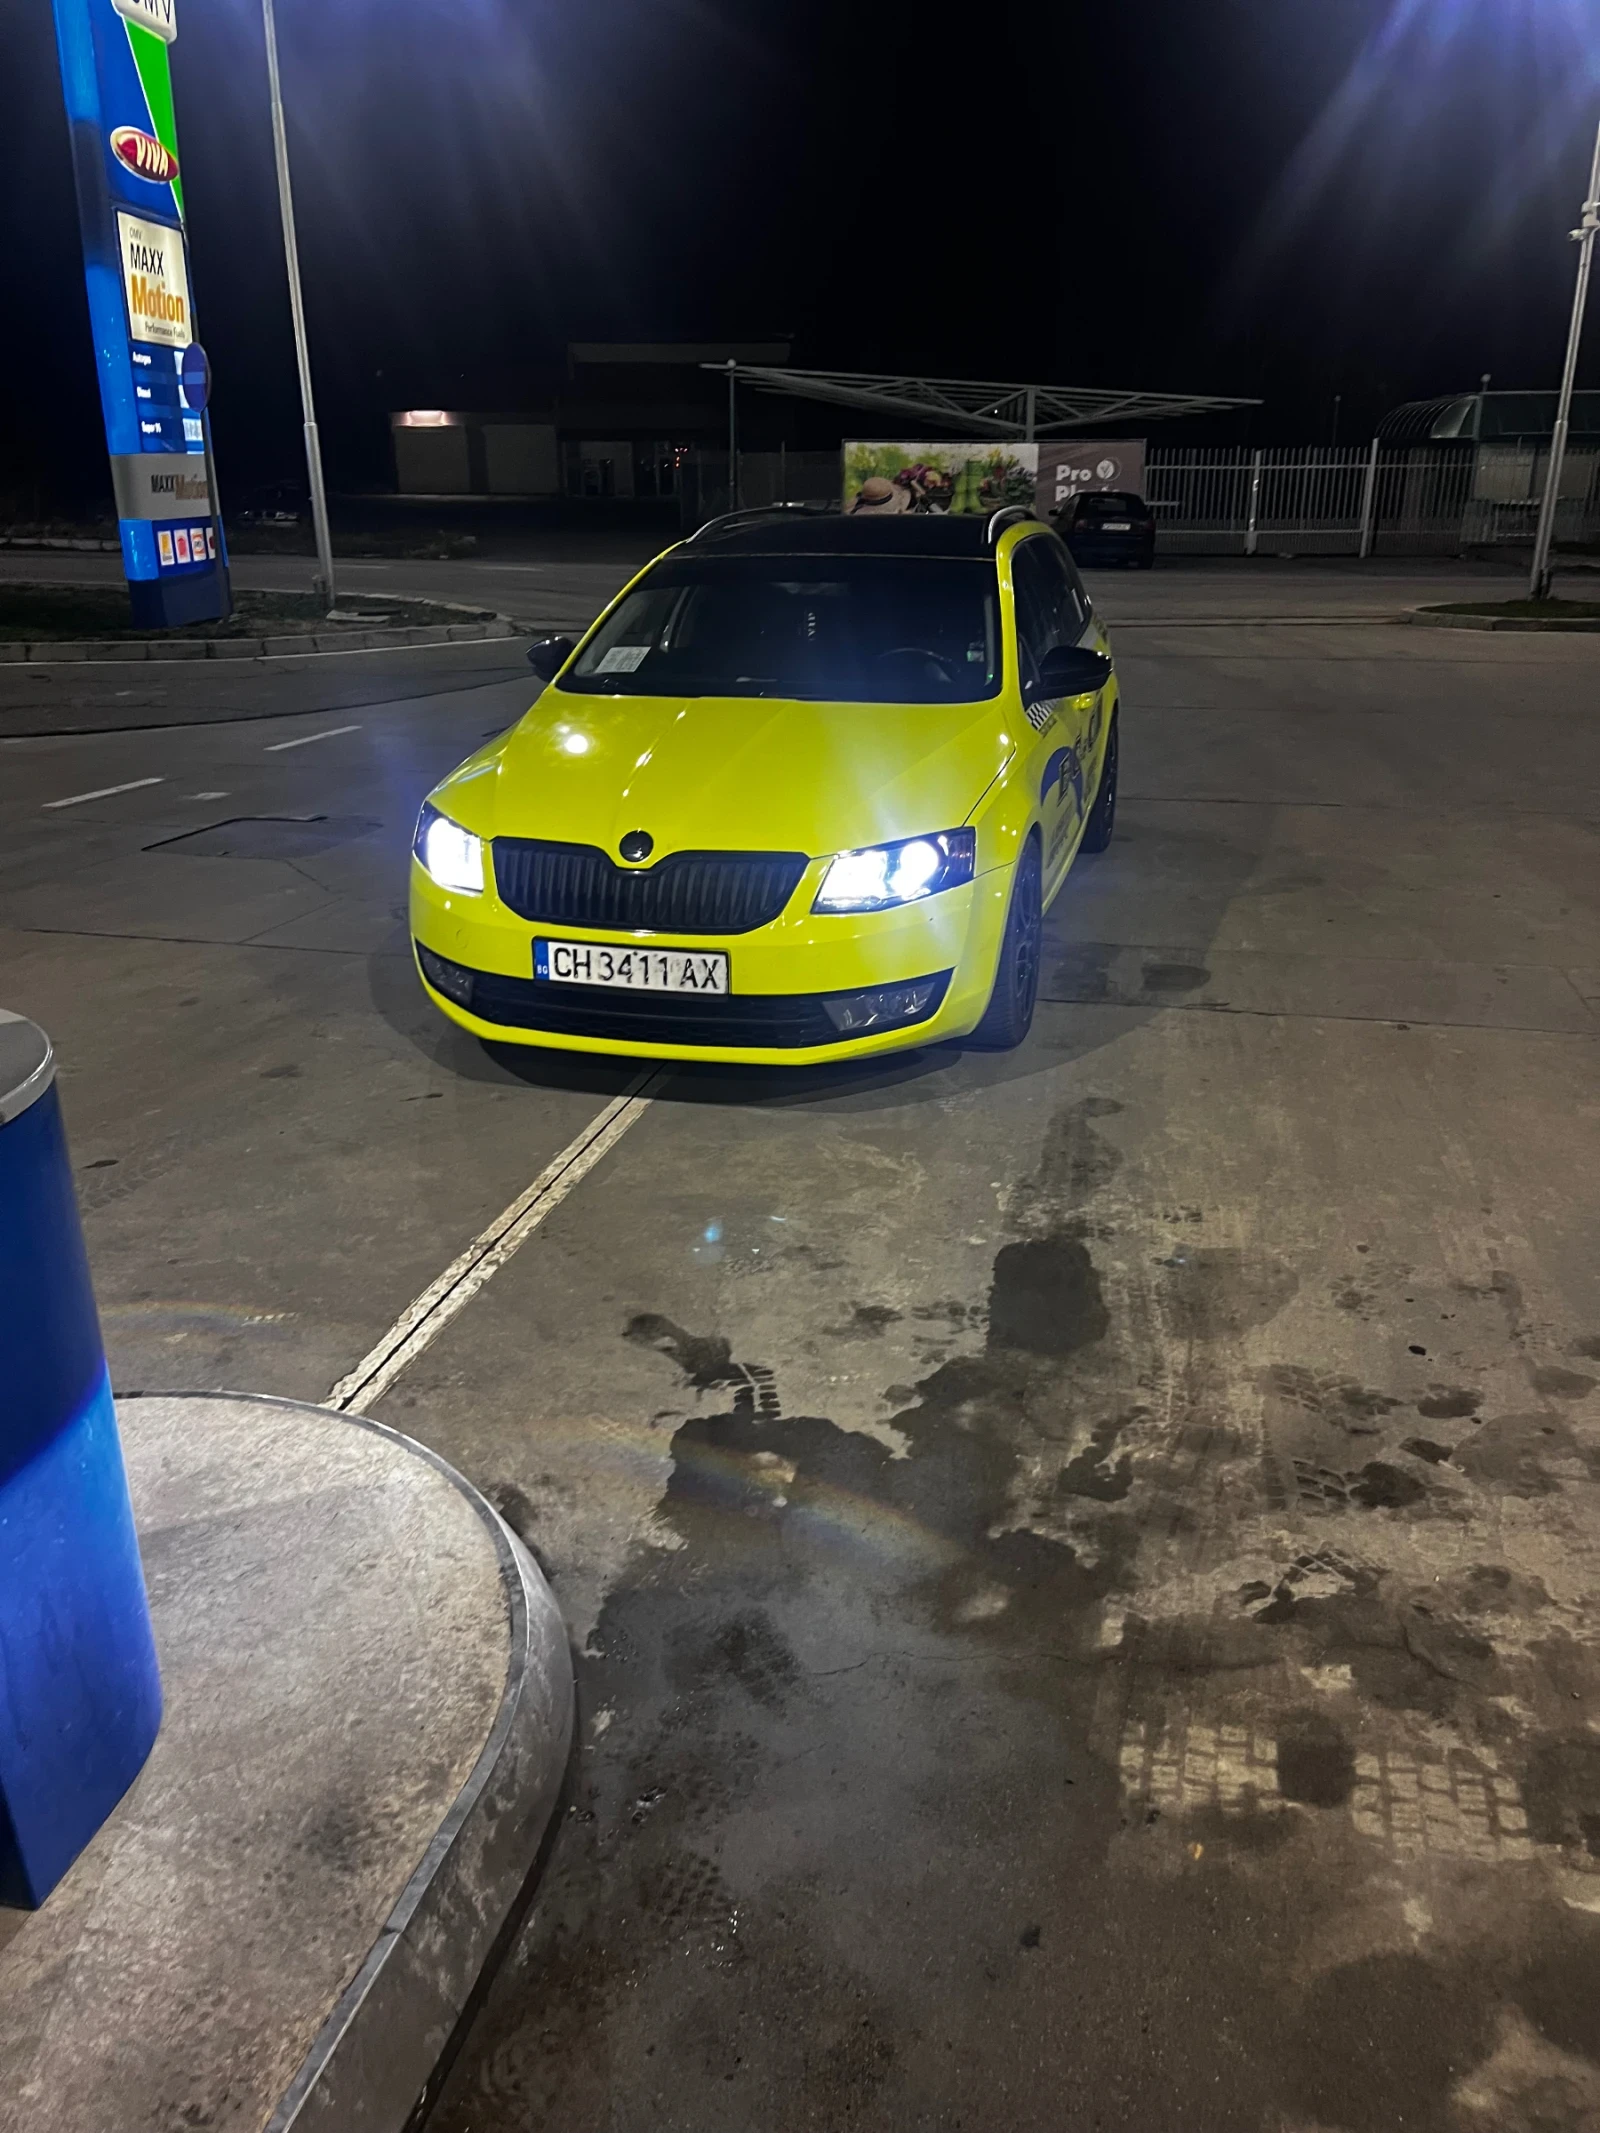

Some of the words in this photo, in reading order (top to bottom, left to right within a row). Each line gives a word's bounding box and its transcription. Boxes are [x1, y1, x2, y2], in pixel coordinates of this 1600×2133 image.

[135, 134, 169, 177] VIVA
[130, 243, 164, 277] MAXX
[131, 273, 185, 324] Motion
[1055, 464, 1092, 481] Pro
[537, 965, 548, 975] BG
[598, 951, 669, 987] 3411
